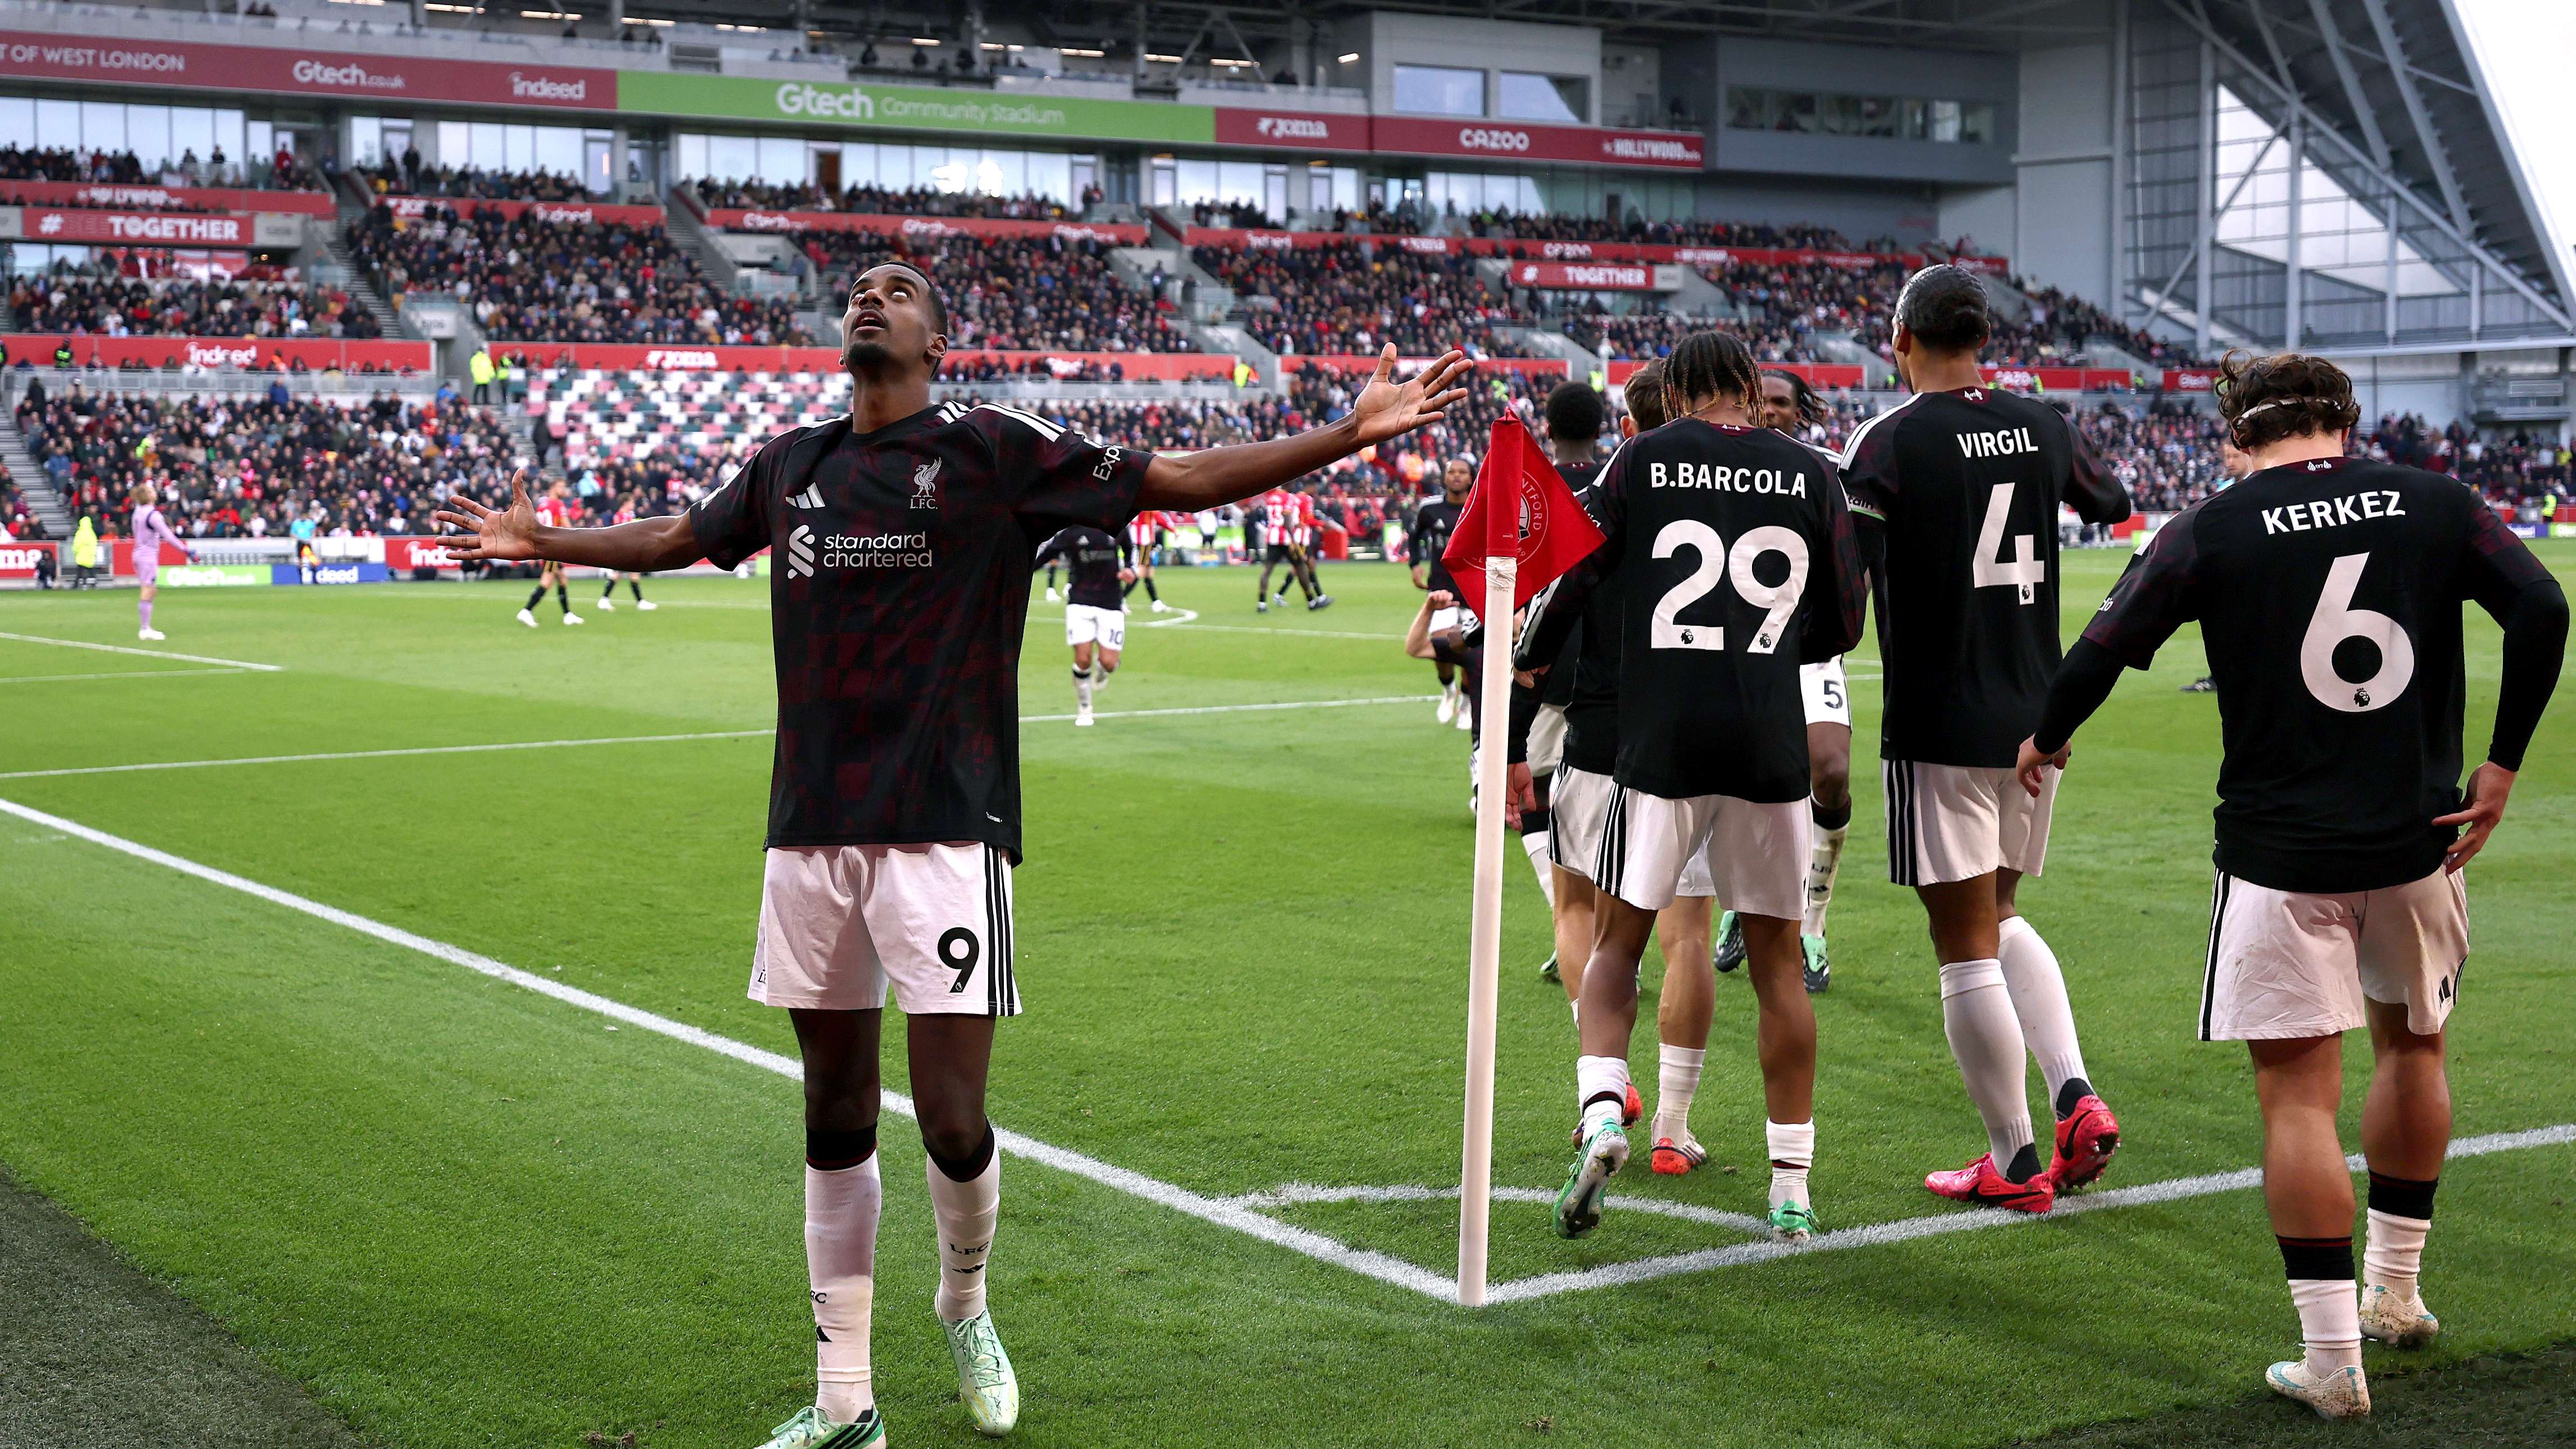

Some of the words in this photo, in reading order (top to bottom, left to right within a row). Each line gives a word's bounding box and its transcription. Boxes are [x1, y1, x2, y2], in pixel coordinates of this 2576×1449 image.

[11, 44, 39, 63] OF
[42, 47, 97, 66] WEST
[99, 50, 185, 71] LONDON
[512, 73, 585, 101] indeed
[776, 83, 875, 118] Gtech
[880, 97, 988, 125] Community
[990, 104, 1065, 125] Stadium
[1459, 129, 1530, 151] CAZOO
[1957, 427, 2039, 459] VIRGIL
[1650, 463, 1806, 499] B.BARCOLA
[1522, 478, 1542, 531] NTFORD
[2261, 490, 2406, 535] KERKEZ
[824, 531, 926, 549] standard
[1972, 482, 2044, 605] 4
[823, 549, 932, 568] chartered
[1651, 519, 1809, 654] 29
[1108, 628, 1124, 645] 10
[2300, 551, 2415, 712] 6
[1823, 680, 1843, 709] 5
[937, 927, 980, 993] 9
[948, 1240, 989, 1255] LFC
